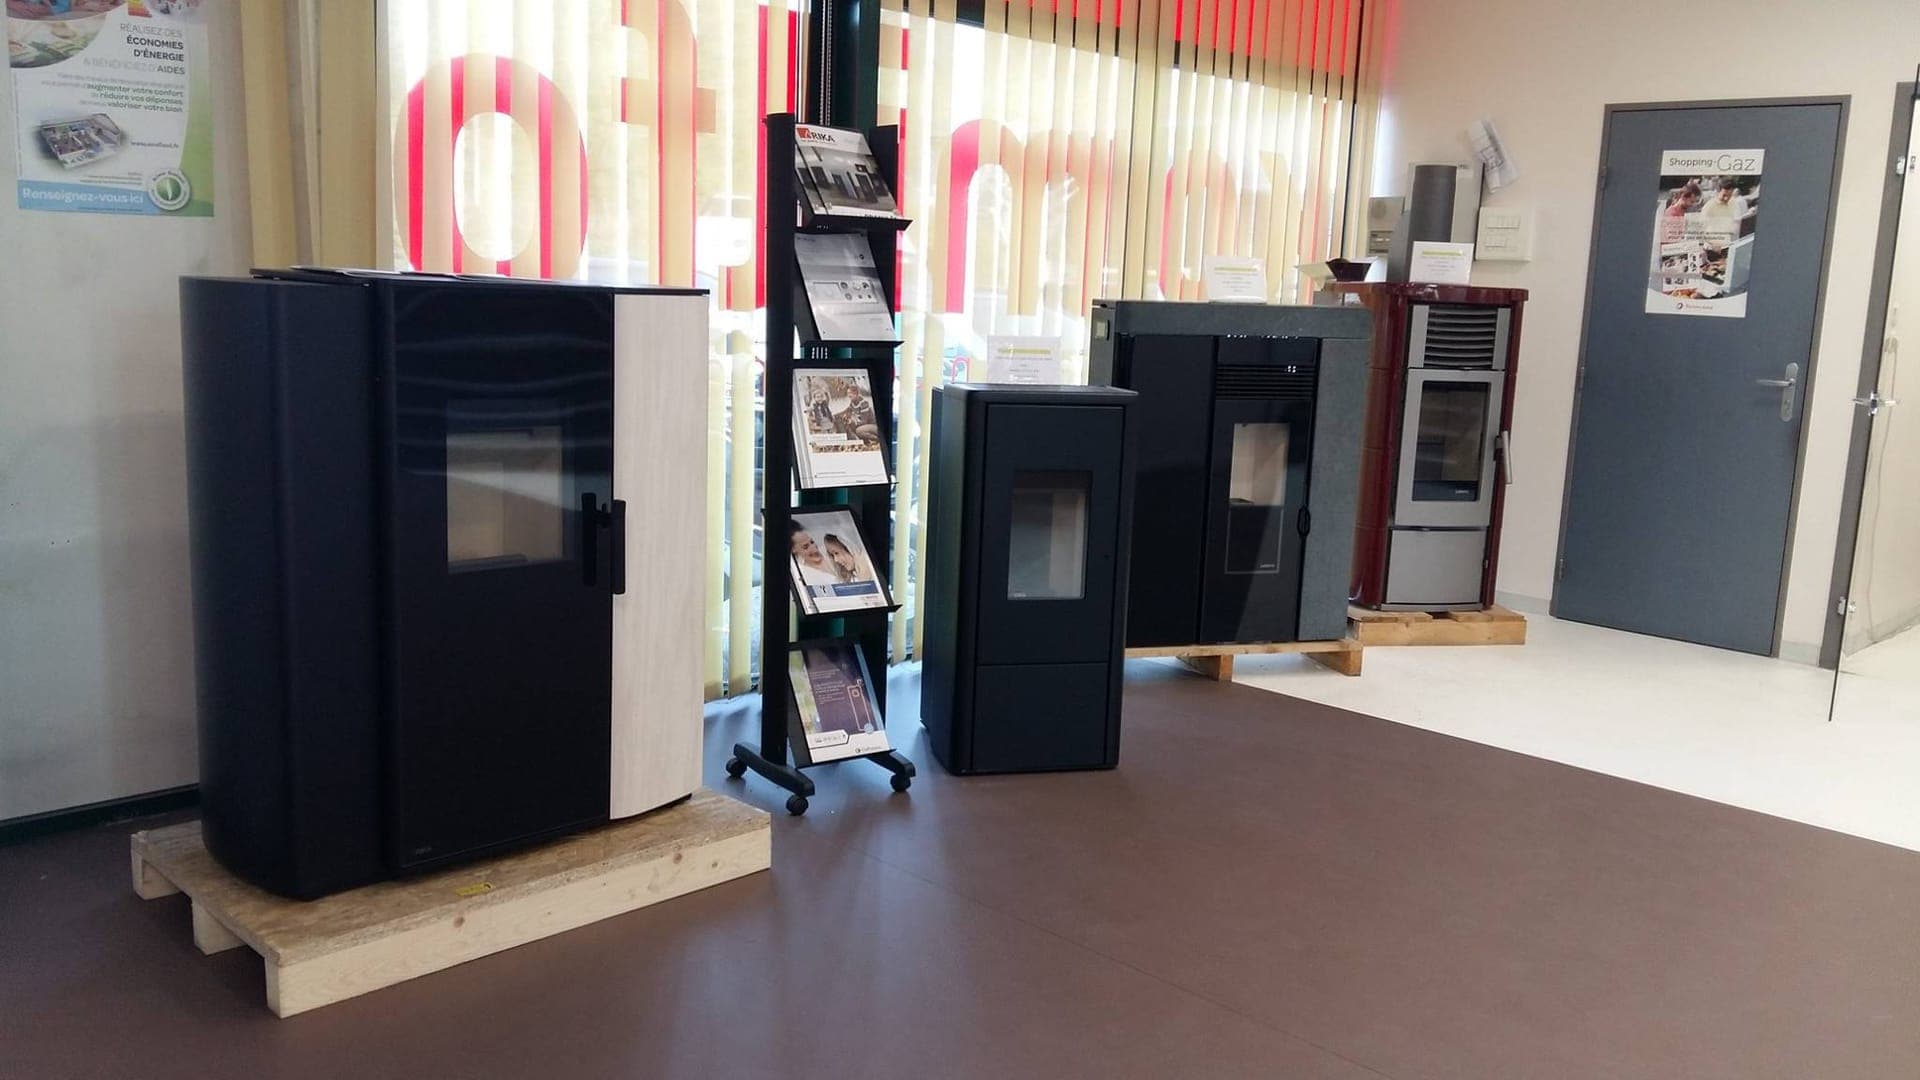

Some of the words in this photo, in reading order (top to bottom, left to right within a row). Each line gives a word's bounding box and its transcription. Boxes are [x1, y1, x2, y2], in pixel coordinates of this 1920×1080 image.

[126, 34, 184, 50] ÉCONOMIES
[133, 48, 185, 62] D'ÉNERGIE
[811, 131, 836, 142] RIKA
